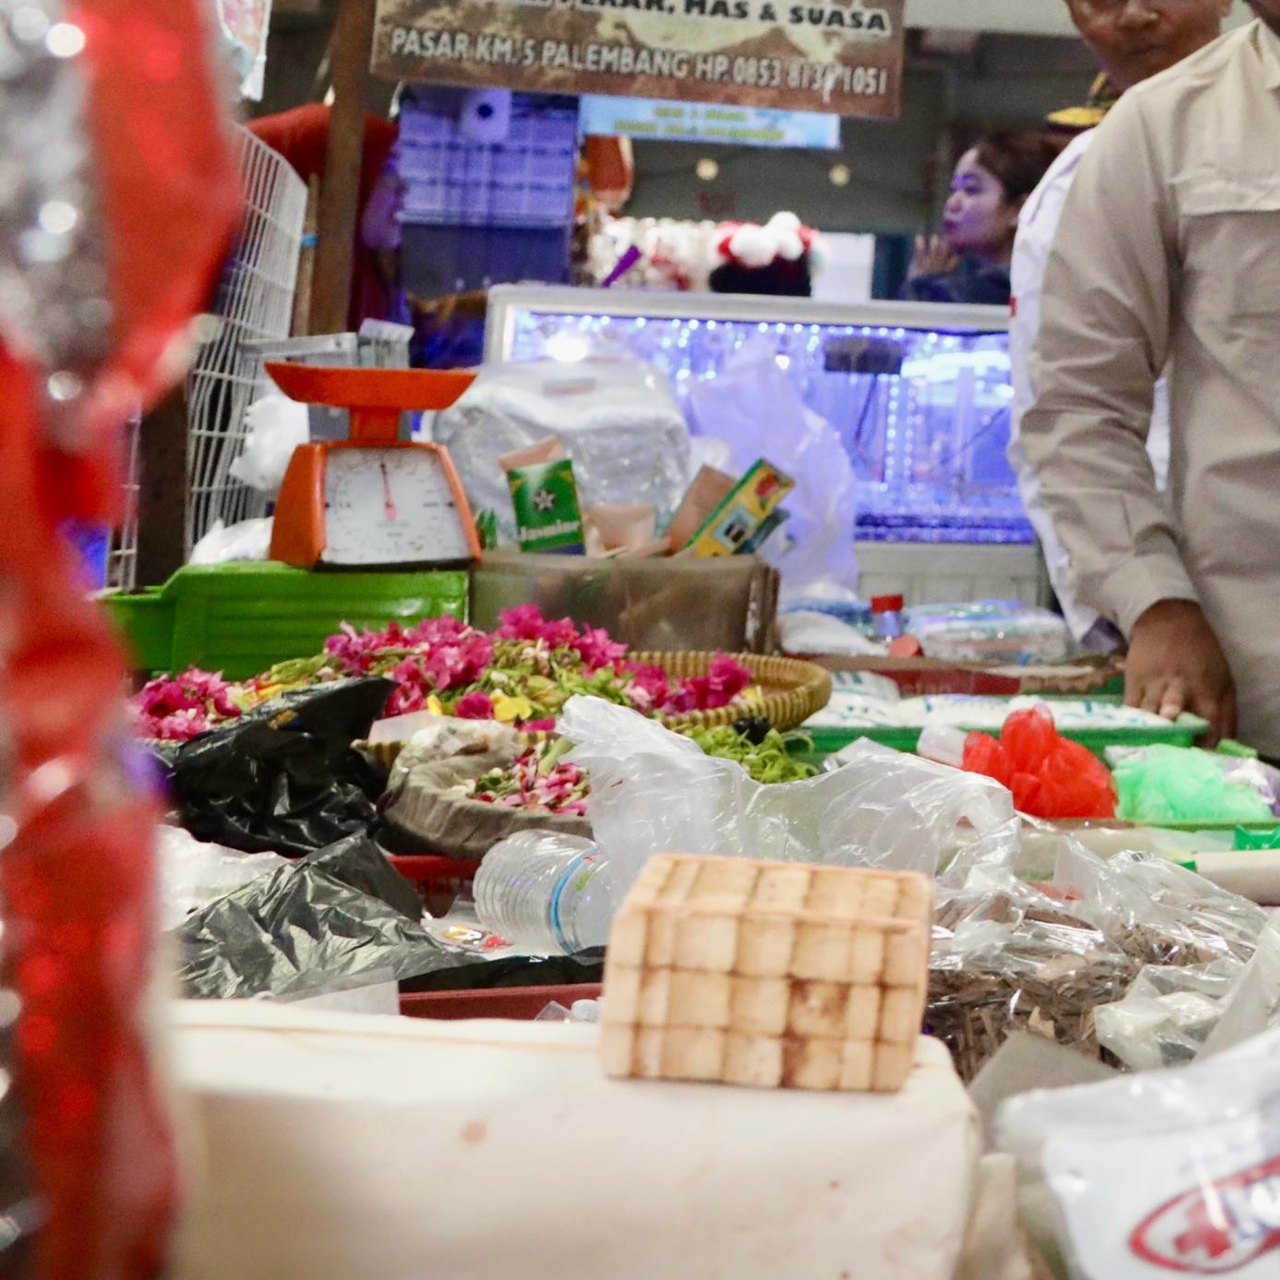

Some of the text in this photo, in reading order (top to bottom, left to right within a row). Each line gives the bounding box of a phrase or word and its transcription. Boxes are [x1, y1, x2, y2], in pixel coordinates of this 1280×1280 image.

[759, 3, 777, 22] &
[789, 6, 886, 32] SUASA
[390, 27, 470, 59] PASAR
[541, 40, 688, 79] PALEMBANG
[732, 56, 781, 87] 0853
